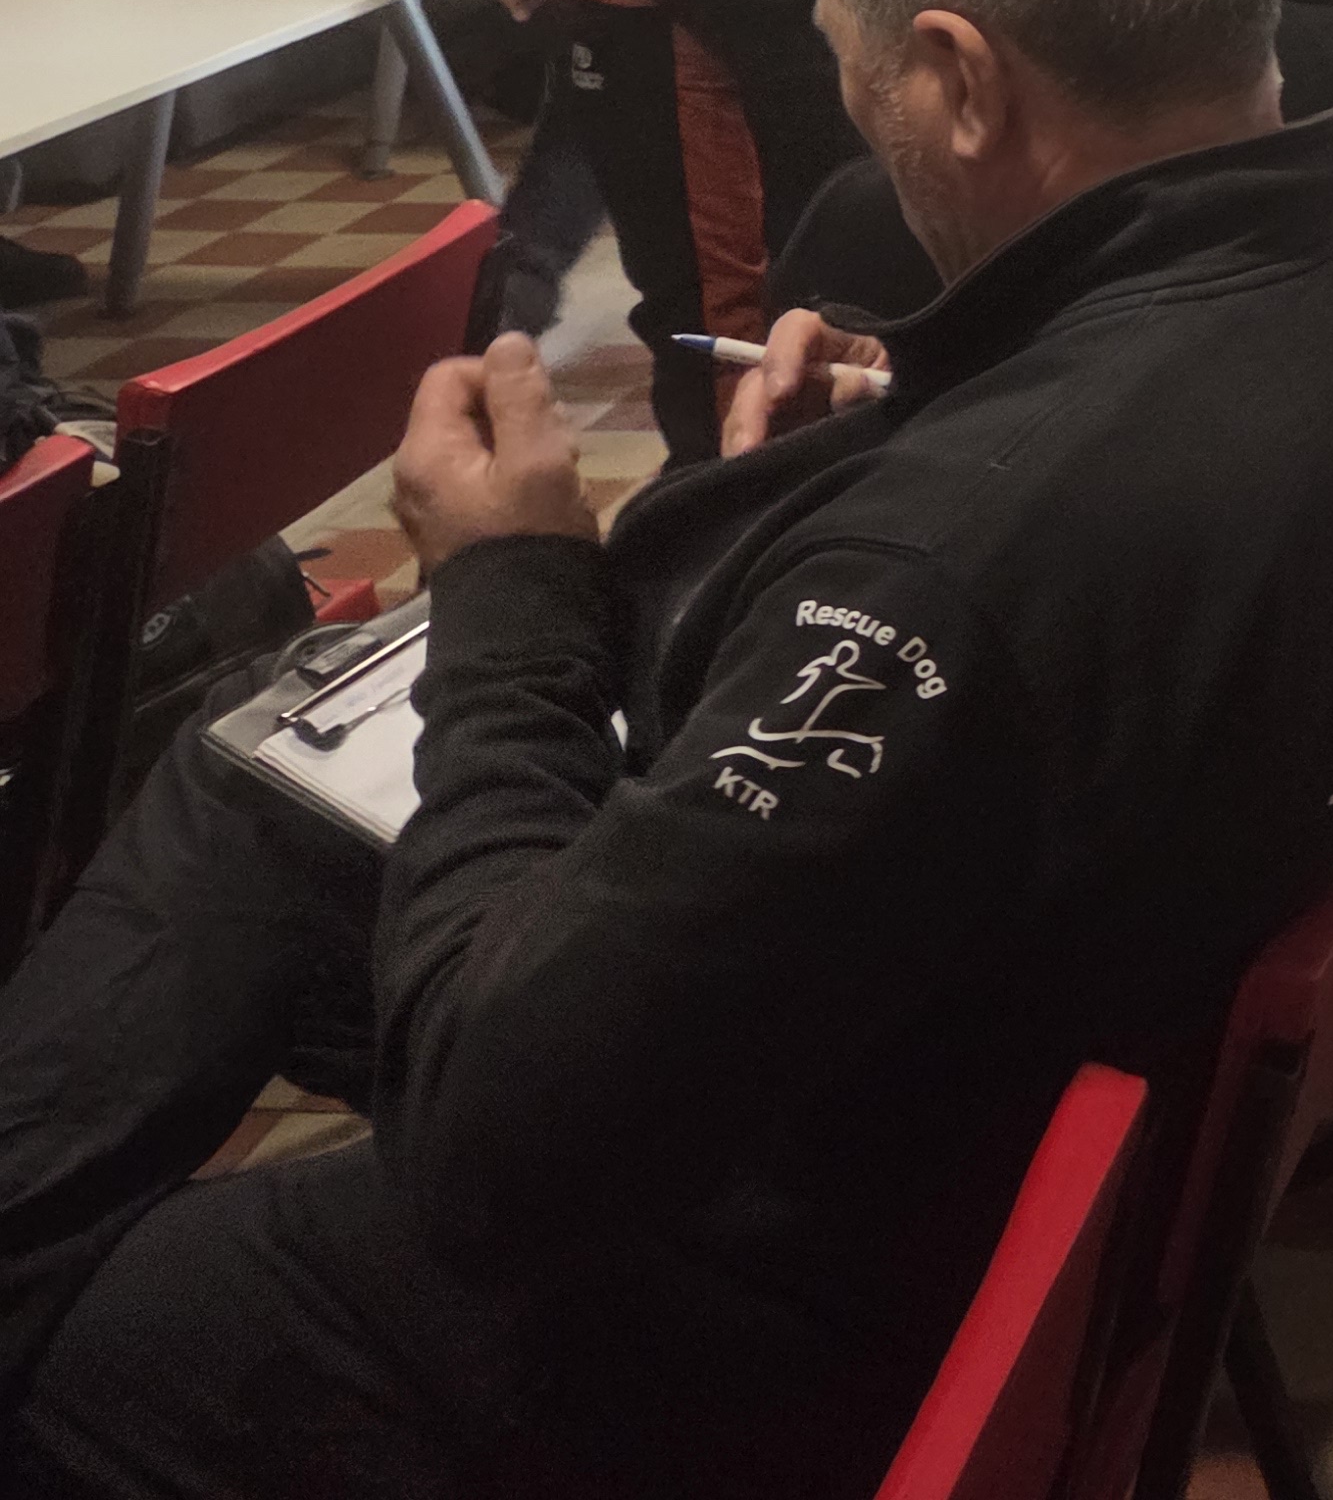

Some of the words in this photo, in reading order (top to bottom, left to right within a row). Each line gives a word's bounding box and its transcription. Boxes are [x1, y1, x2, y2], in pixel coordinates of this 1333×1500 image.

[795, 599, 897, 646] Rescue
[896, 635, 948, 700] Dog
[713, 766, 779, 820] KTR
